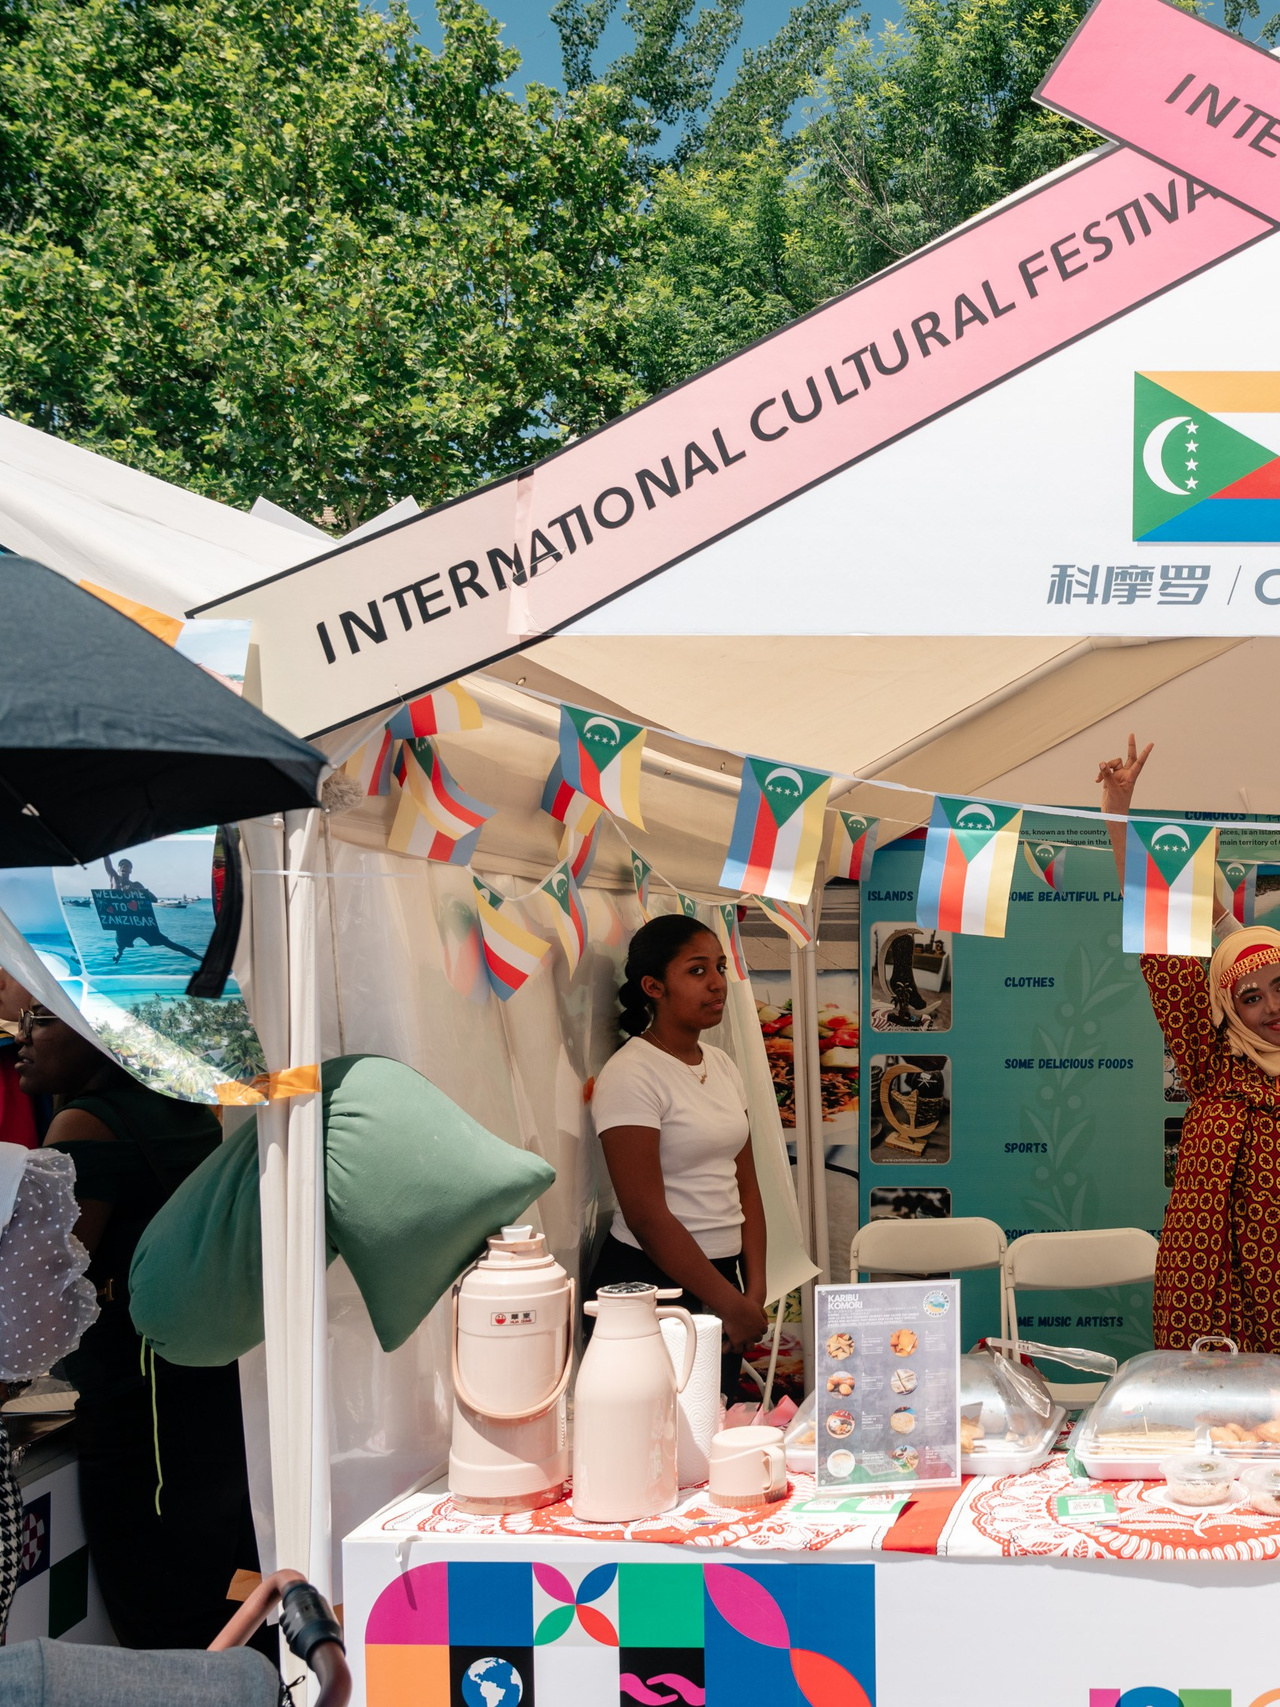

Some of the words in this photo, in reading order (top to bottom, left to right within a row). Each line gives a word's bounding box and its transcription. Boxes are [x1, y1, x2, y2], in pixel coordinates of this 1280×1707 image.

[316, 428, 746, 664] INTERNATIONAL
[750, 280, 1016, 442] CULTURAL
[1019, 177, 1219, 299] FESTIVA
[1046, 564, 1211, 605] 科摩罗
[1080, 829, 1107, 837] country
[1238, 839, 1268, 847] territory
[868, 890, 914, 901] ISLANDS
[1038, 891, 1099, 902] BEAUTIFUL
[112, 902, 128, 912] TO
[100, 915, 156, 926] ZANZIBAR
[1004, 977, 1055, 988] CLOTHES
[1004, 1058, 1034, 1069] SOME
[1038, 1058, 1094, 1069] DELICIOUS
[1098, 1058, 1134, 1069] FOODS
[1004, 1143, 1048, 1154] SPORTS
[828, 1293, 859, 1303] KARIBU
[828, 1301, 863, 1310] KOMORI
[1038, 1316, 1072, 1327] MUSIC
[1075, 1316, 1123, 1327] ARTISTS
